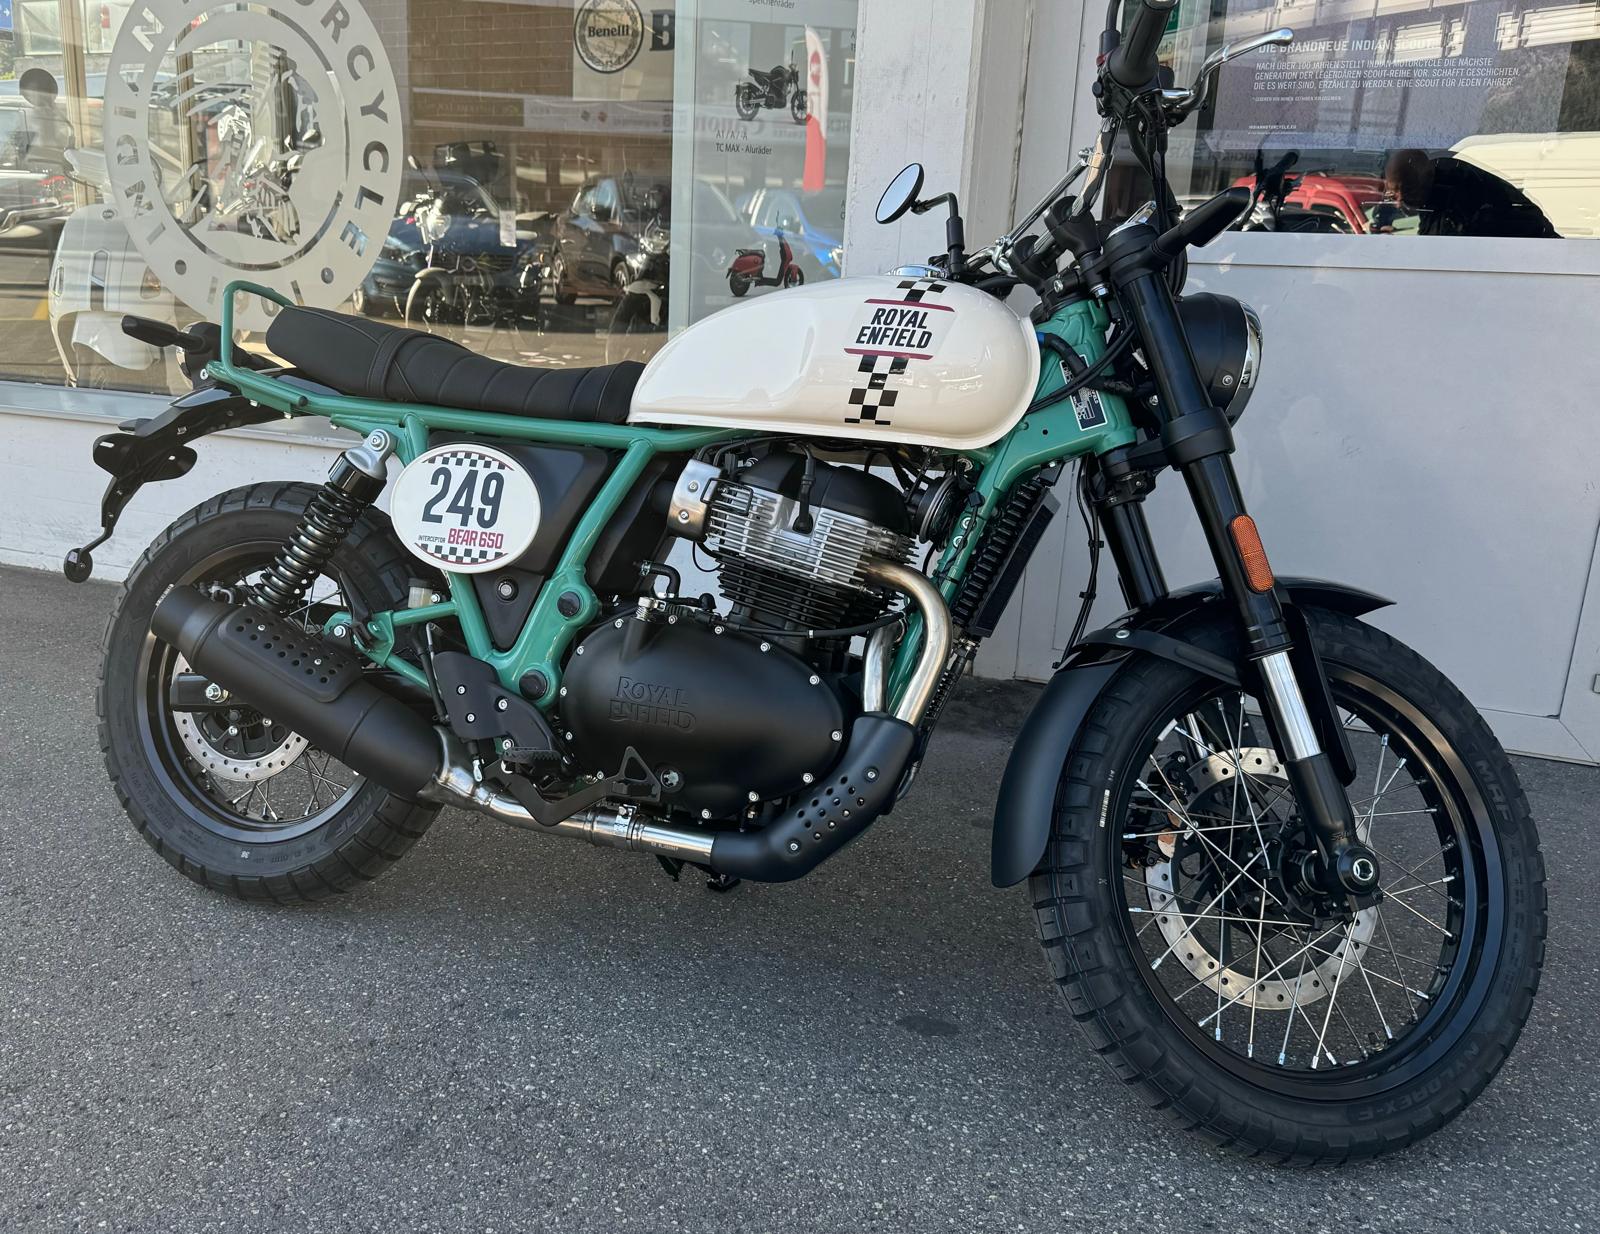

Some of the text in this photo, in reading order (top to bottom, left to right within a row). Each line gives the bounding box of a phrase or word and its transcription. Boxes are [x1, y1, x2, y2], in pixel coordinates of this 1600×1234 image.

[588, 25, 630, 38] Benelli
[1259, 43, 1276, 53] DIE
[1280, 40, 1348, 53] BRANDNEUE
[1351, 39, 1390, 51] INDIAN
[1256, 56, 1493, 70] NACH ÜBER 100 JAHREN STELLT INDIAN MOTORCYCLE DIE NÄCHSTE
[1255, 67, 1520, 80] GENERATION DER LEGENDÄREN SCOUT-REIHE VOR. SCHAFFT GESCHICHTEN,
[1253, 81, 1265, 90] DIE
[1267, 80, 1276, 90] ES
[1277, 80, 1296, 89] WERT
[1297, 80, 1317, 90] SIND,
[1318, 77, 1349, 89] ERZÄHLT
[1351, 79, 1360, 88] ZU
[1362, 79, 1394, 88] WERDEN.
[1396, 79, 1414, 88] EINE
[1415, 79, 1440, 88] SCOUT
[1441, 77, 1456, 87] FÜR
[1458, 78, 1481, 87] JEDEN
[716, 143, 724, 153] TC
[725, 143, 740, 153] MAX
[745, 144, 772, 155] Aluräder
[871, 307, 928, 329] ROYAL
[855, 326, 933, 349] ENFIELD
[421, 466, 505, 529] 249
[418, 528, 504, 550] INTERCEPTOR BEAR 650
[616, 675, 689, 707] ROYAL
[607, 699, 697, 734] ENFIELD
